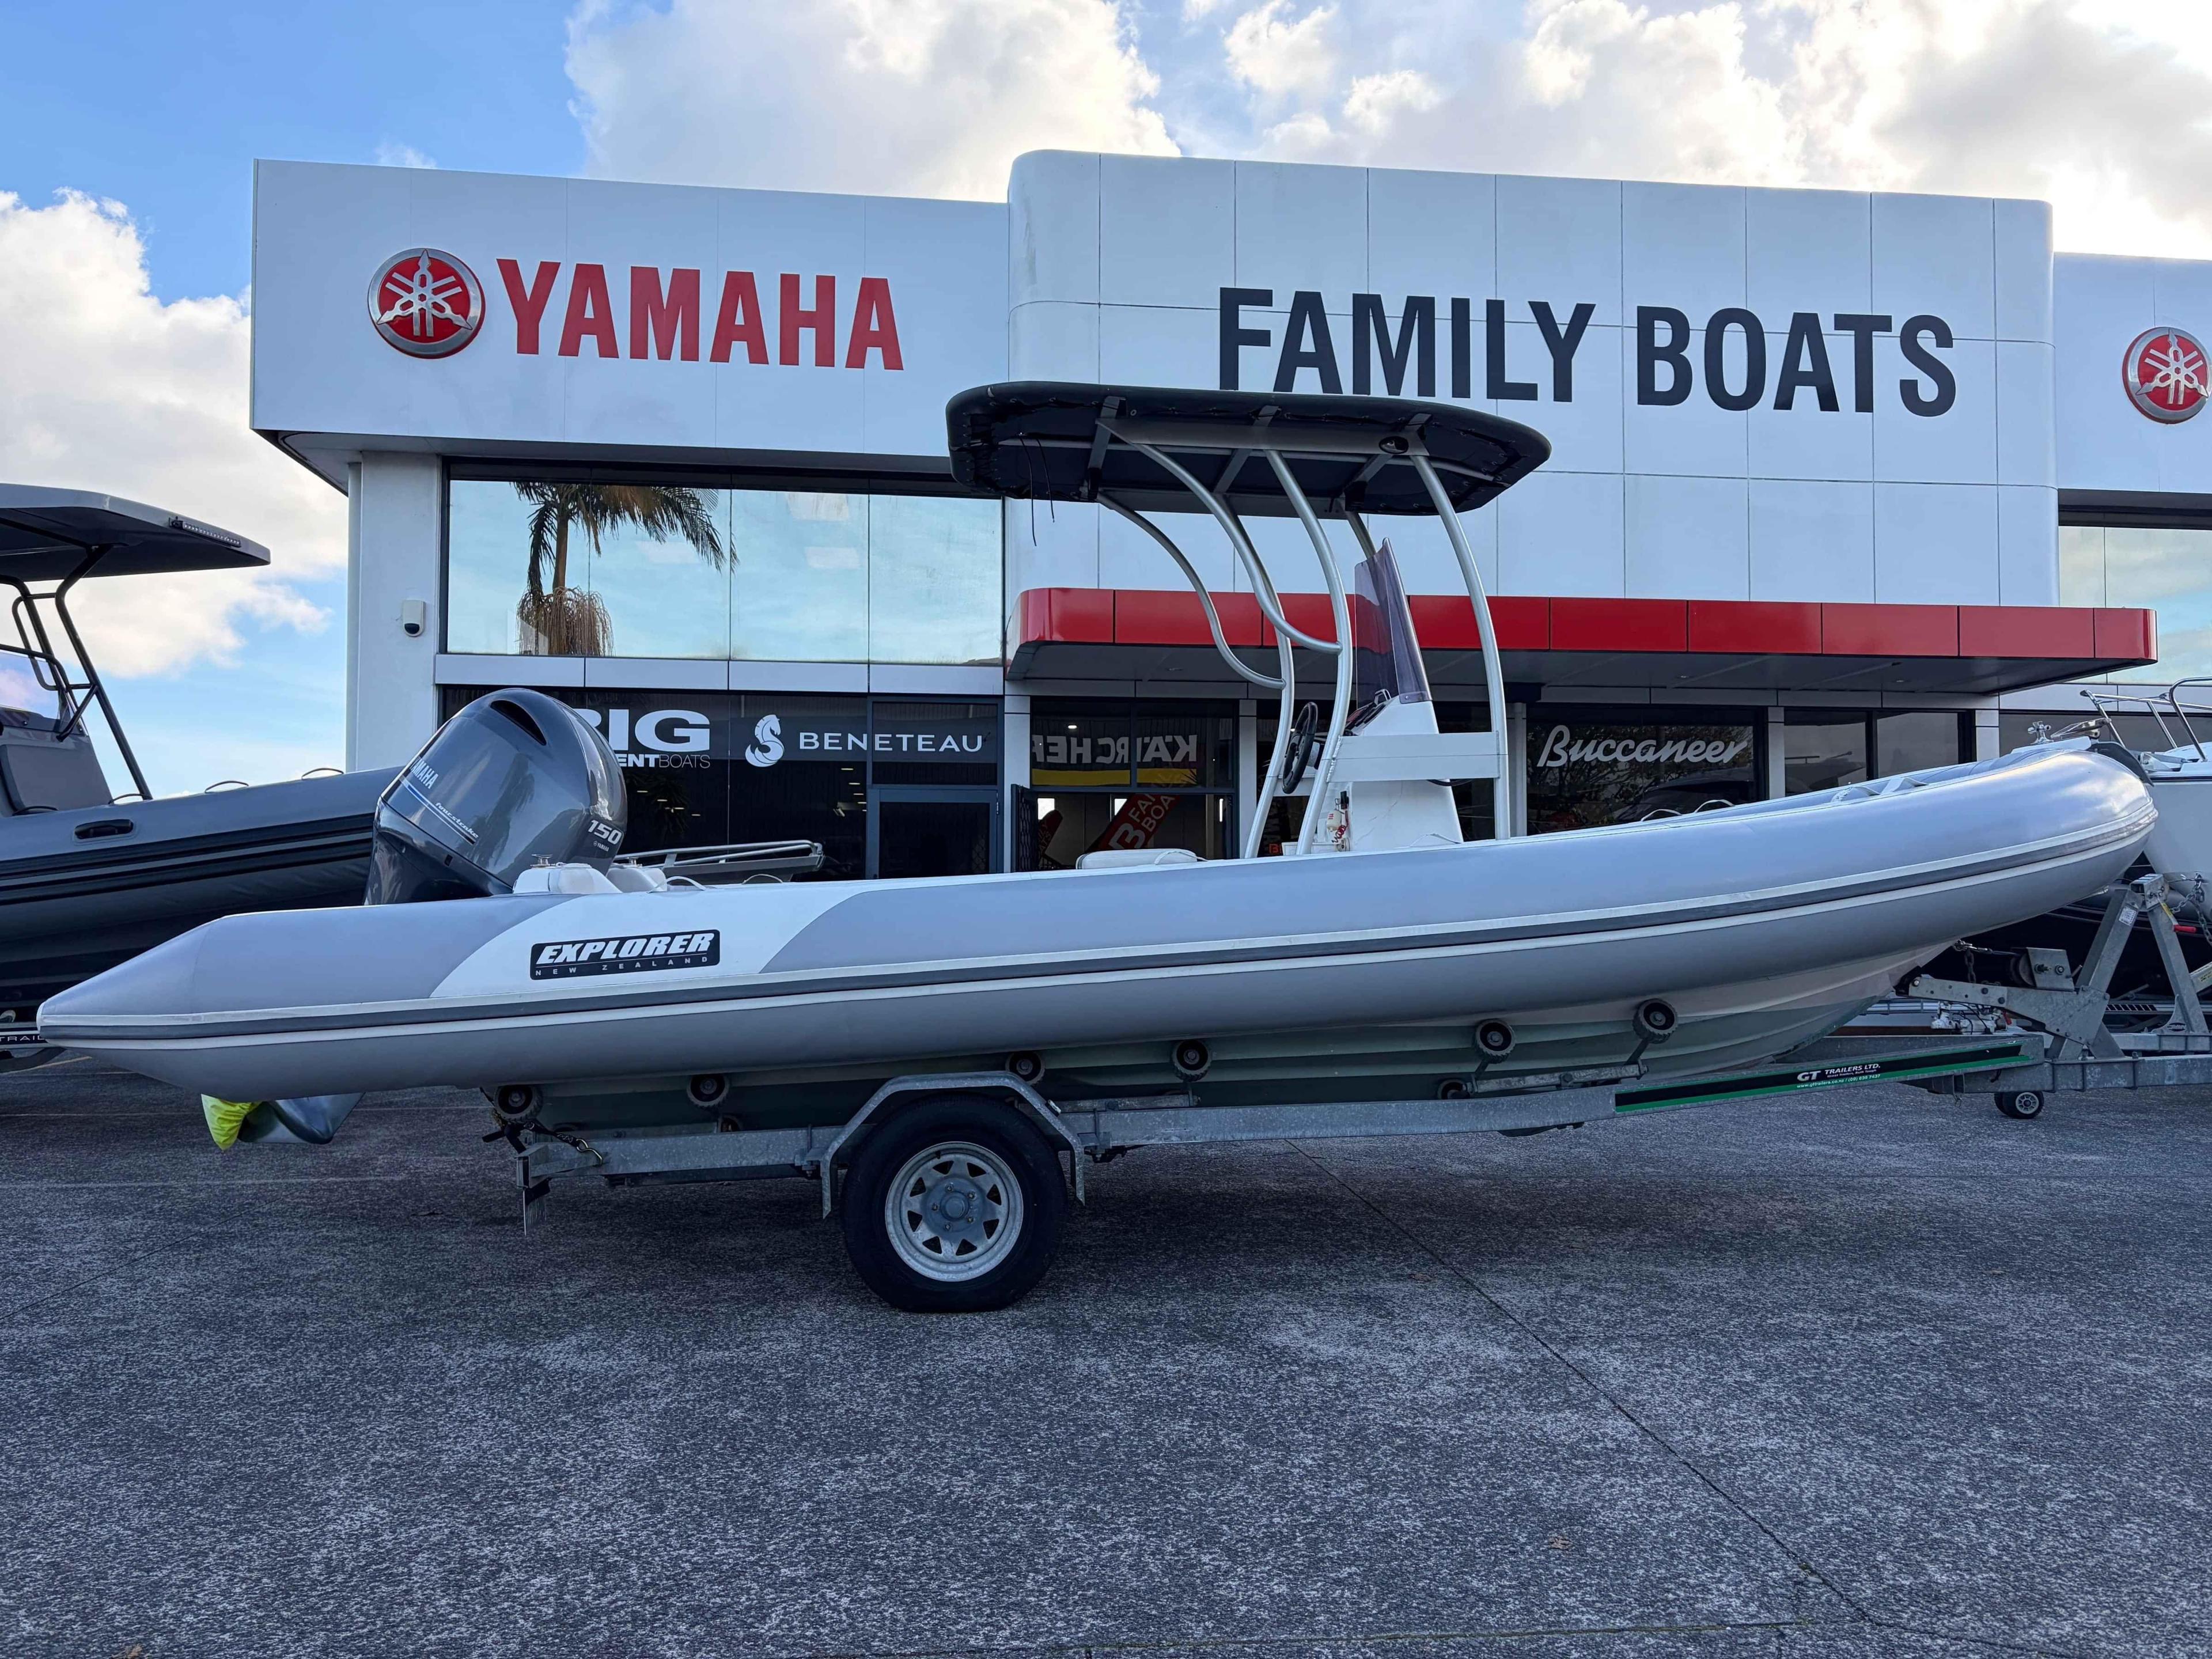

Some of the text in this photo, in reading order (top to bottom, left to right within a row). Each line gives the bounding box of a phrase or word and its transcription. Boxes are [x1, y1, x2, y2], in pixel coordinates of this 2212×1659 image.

[496, 258, 904, 370] YAMAHA
[1219, 286, 1956, 417] FAMILY BOATS
[799, 732, 983, 752] BENETEAU
[1536, 724, 1748, 768] Buccaneer
[410, 756, 439, 790] AMAHA
[614, 753, 711, 769] ENTBOATS
[588, 820, 622, 845] 150
[536, 933, 715, 965] EXPLORER
[536, 956, 708, 976] NEW ZEALAND
[1797, 1070, 1821, 1082] GT
[1825, 1066, 1863, 1075] TRAILERS
